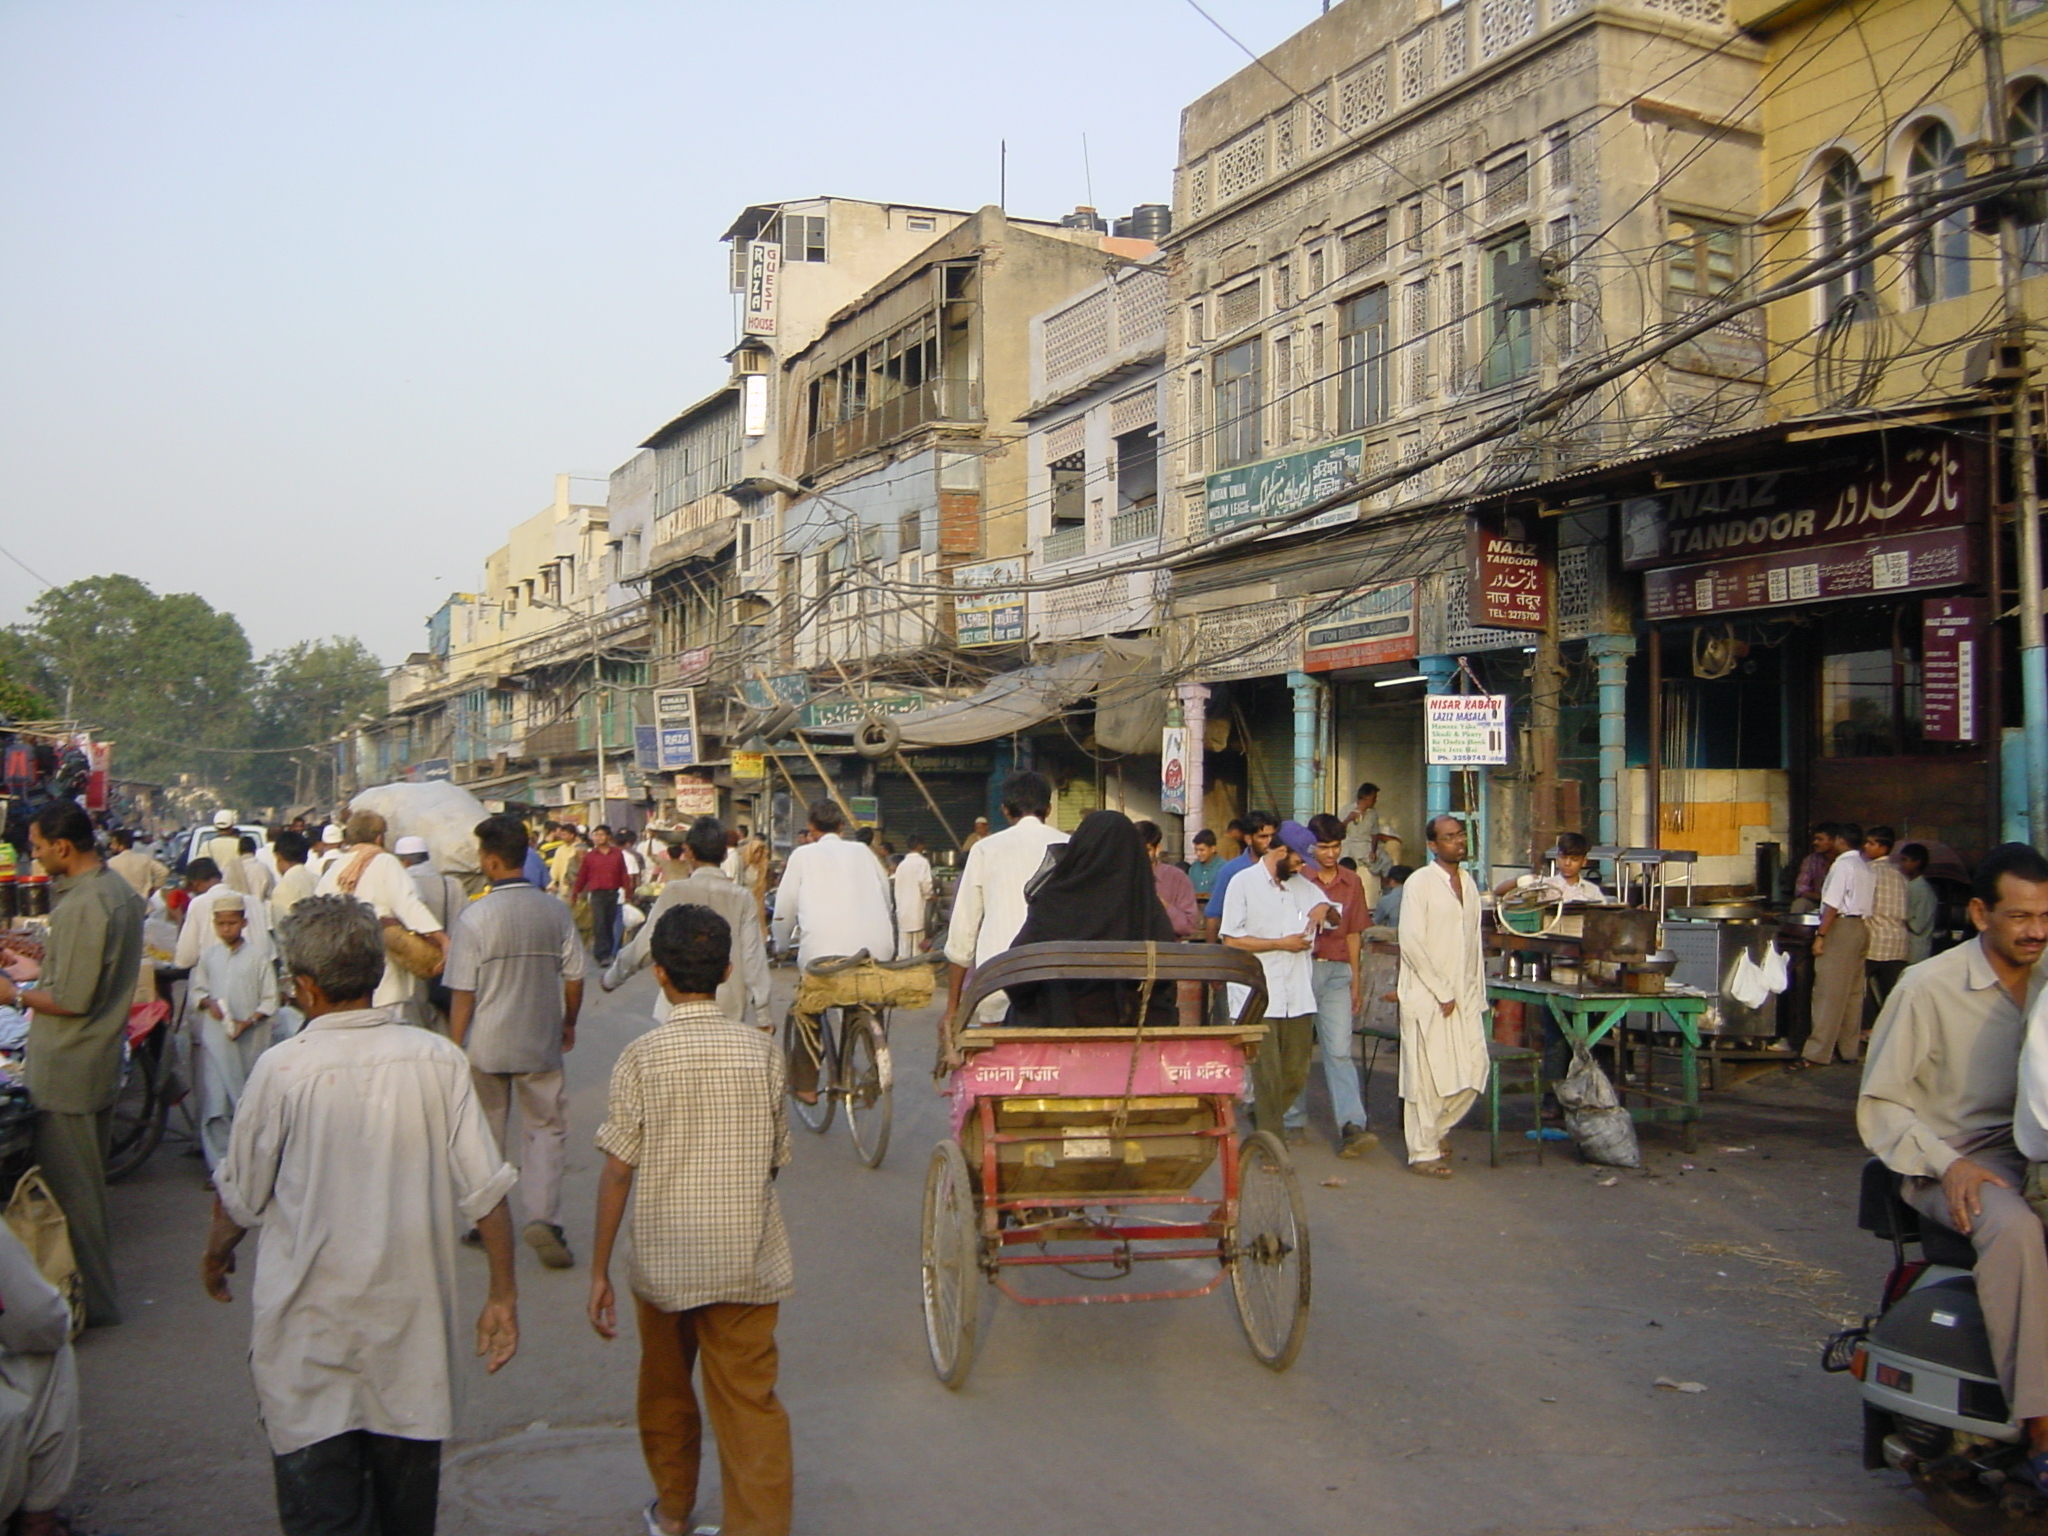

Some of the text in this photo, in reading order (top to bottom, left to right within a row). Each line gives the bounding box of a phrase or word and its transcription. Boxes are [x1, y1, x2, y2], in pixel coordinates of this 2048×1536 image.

[751, 247, 764, 310] RAZA
[764, 249, 777, 311] GUEST
[748, 317, 774, 331] HOUSE
[1668, 473, 1780, 522] NAAZ
[1669, 508, 1816, 555] TANDOOR
[1487, 539, 1538, 556] NAAZ
[1486, 554, 1538, 567] TANDOOR
[1516, 591, 1541, 610] तंदूर
[1488, 608, 1507, 619] TEL:
[1430, 699, 1461, 710] NISAR
[1433, 712, 1487, 722] LAZIZ MASALA
[664, 733, 690, 746] RAZA
[975, 1066, 1015, 1081] जमना
